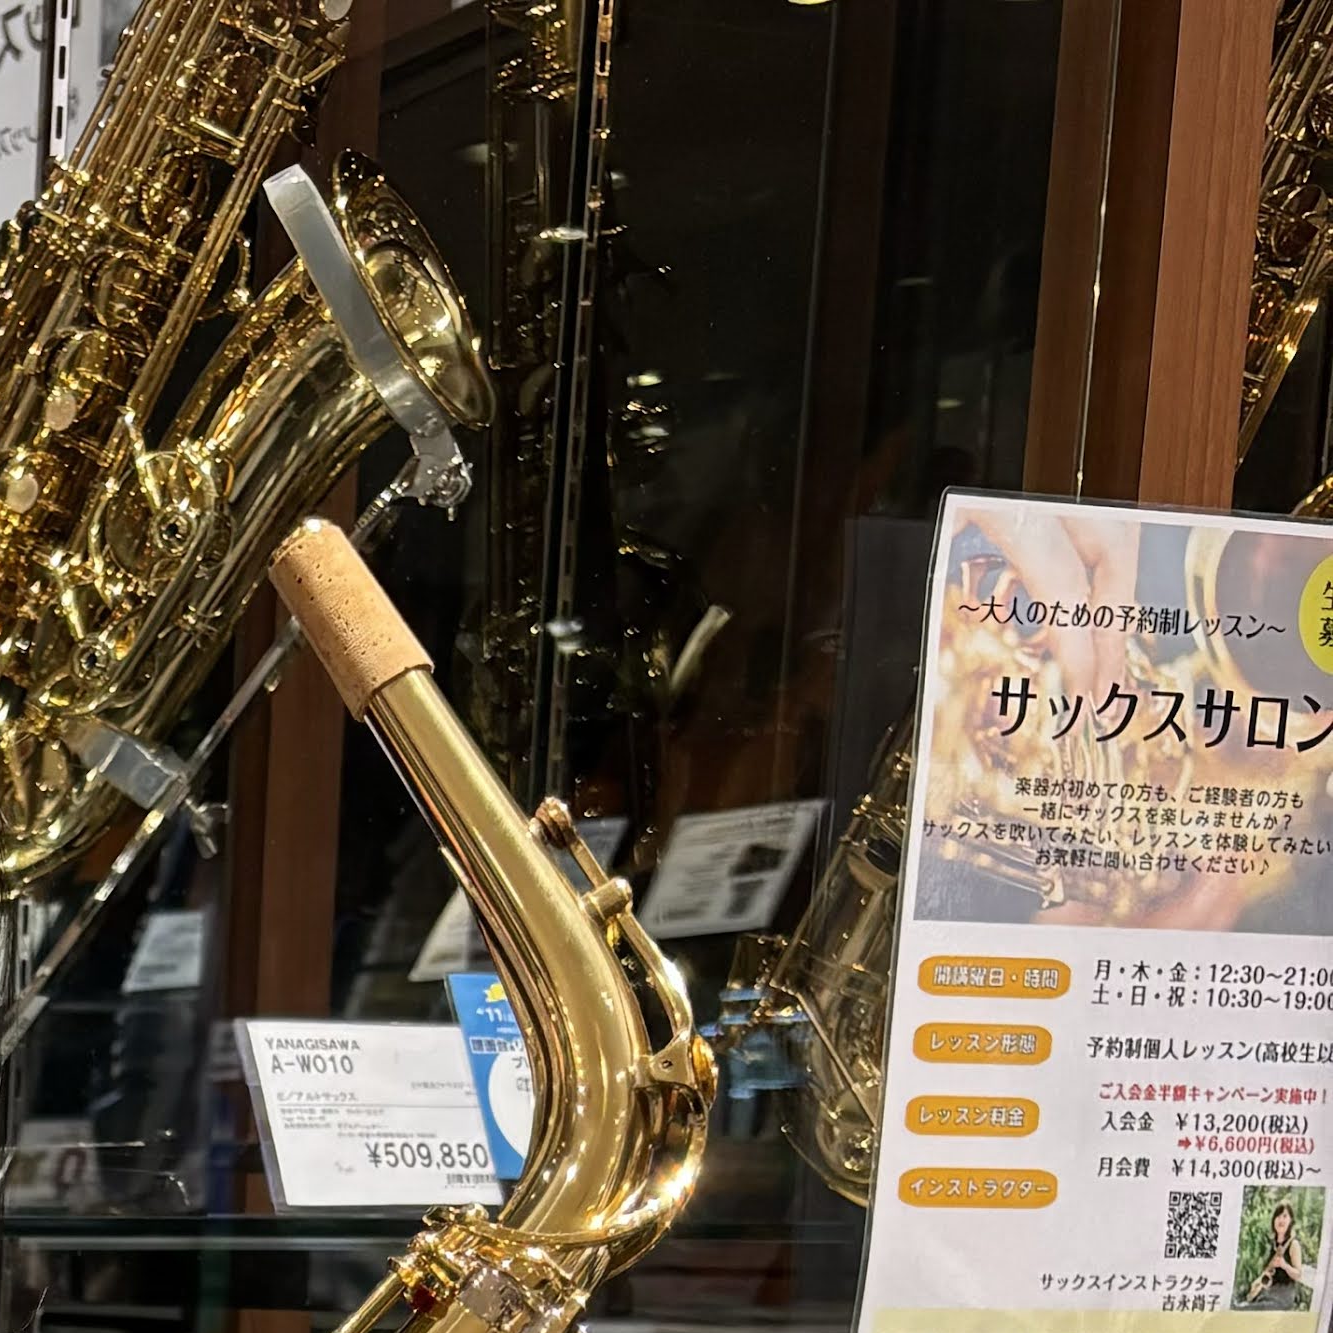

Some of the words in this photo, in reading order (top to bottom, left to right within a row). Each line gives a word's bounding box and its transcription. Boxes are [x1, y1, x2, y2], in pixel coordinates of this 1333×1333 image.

[991, 675, 1333, 753] サックスサロン
[1014, 777, 1305, 809] 楽器が初めての方も、ご経験者の方も
[1022, 801, 1293, 831] 一緒にサックスを楽しみませんか？
[1093, 959, 1333, 987] 月・木・金：12:30～21:0
[265, 1037, 361, 1051] YANAGISAWA
[919, 1106, 1025, 1128] レッスン料金
[1100, 1110, 1155, 1132] 入会金
[364, 1142, 489, 1171] ¥509,850
[1097, 1156, 1151, 1178] 月会費
[910, 1178, 1051, 1198] インストラクター
[1040, 1273, 1225, 1293] サックスインストラクター
